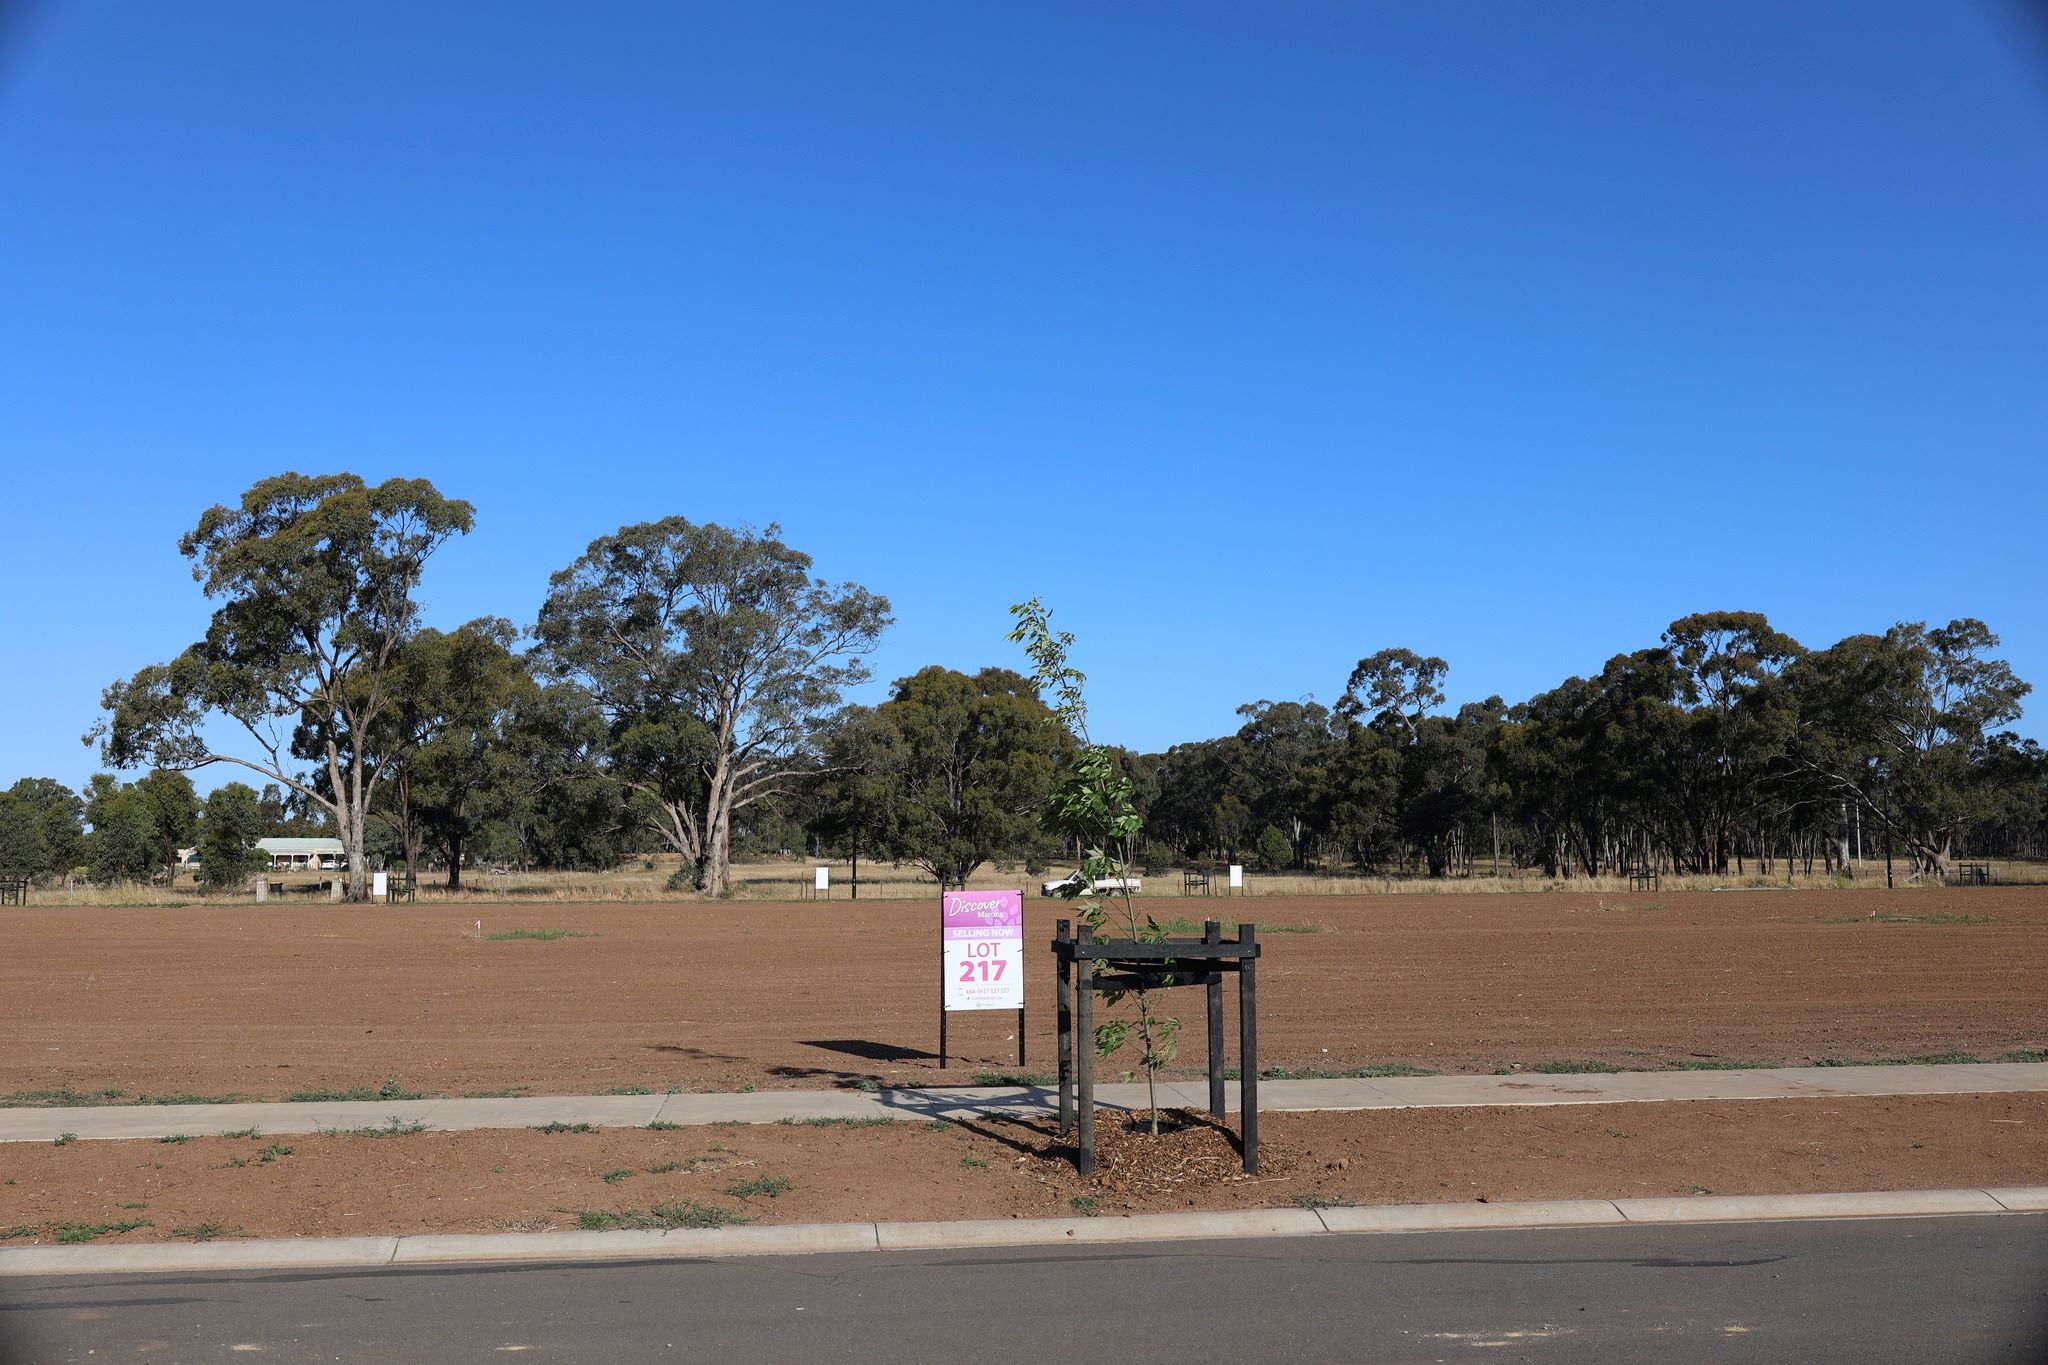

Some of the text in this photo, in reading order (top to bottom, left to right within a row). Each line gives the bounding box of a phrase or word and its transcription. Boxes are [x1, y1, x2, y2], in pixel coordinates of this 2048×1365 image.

[948, 897, 1004, 917] Discover
[977, 911, 1004, 919] Marong
[952, 927, 1014, 938] SELLING NOW
[967, 942, 1001, 958] LOT
[959, 959, 1007, 982] 217
